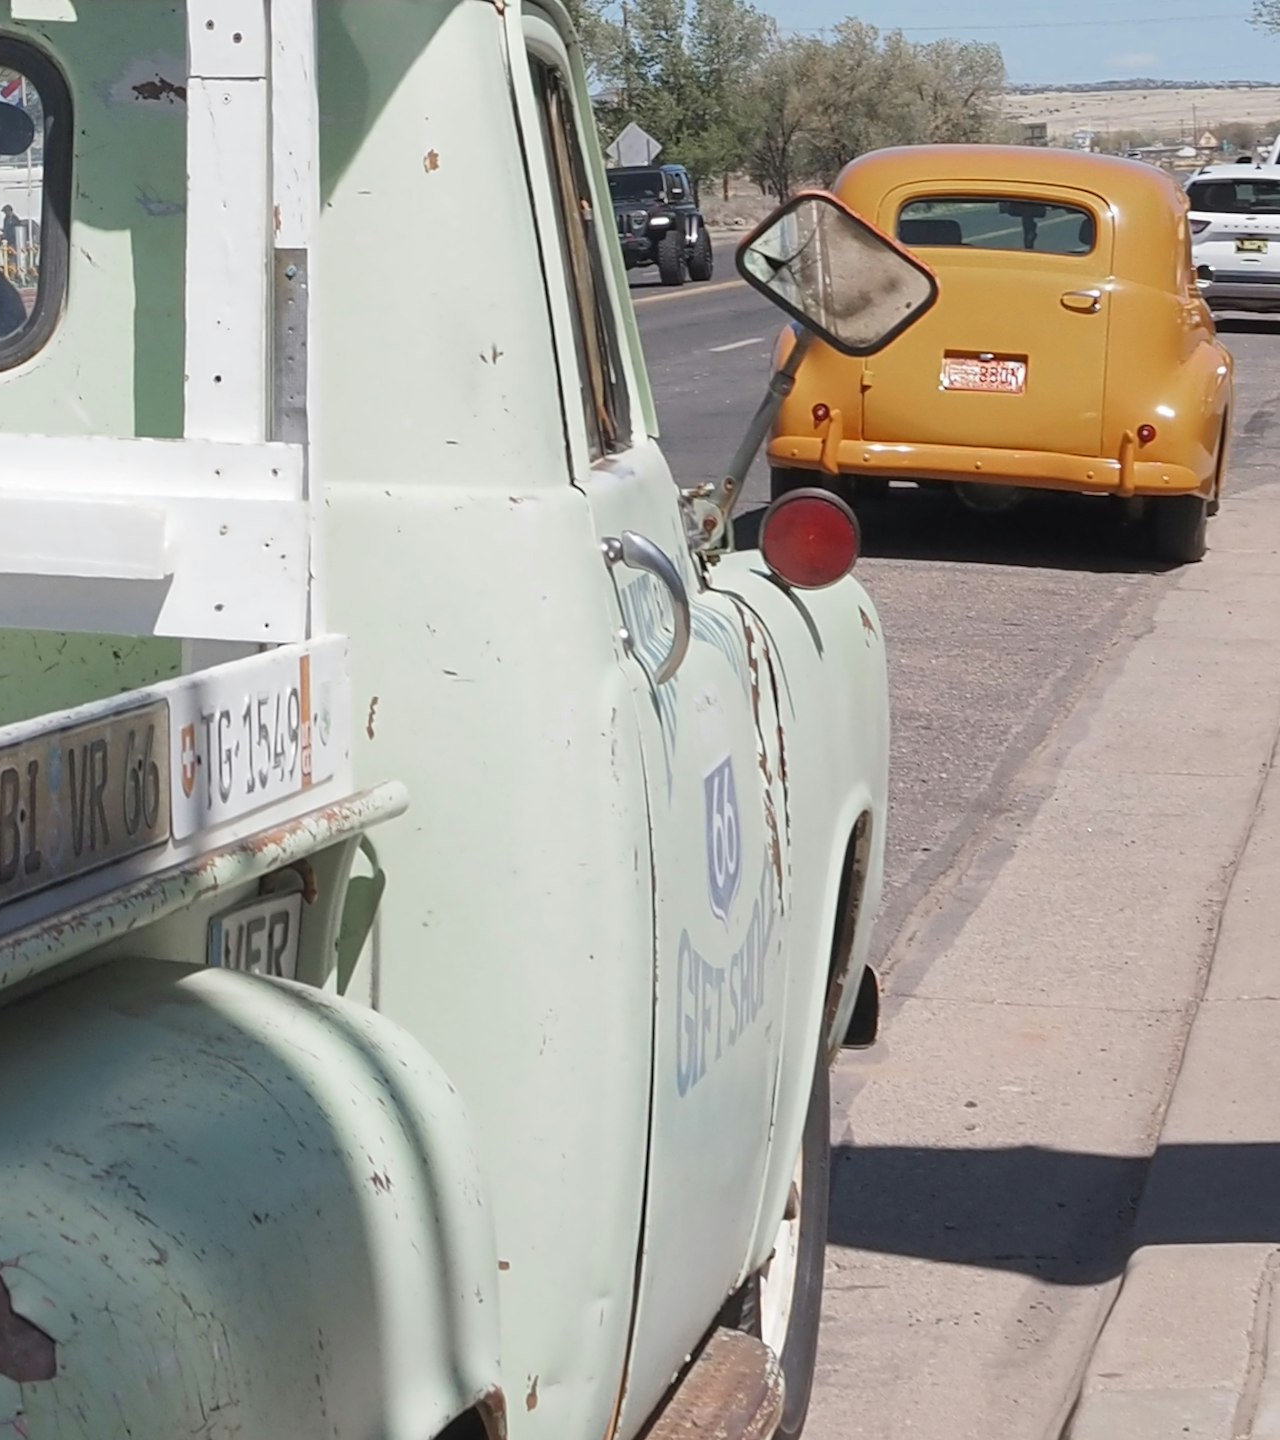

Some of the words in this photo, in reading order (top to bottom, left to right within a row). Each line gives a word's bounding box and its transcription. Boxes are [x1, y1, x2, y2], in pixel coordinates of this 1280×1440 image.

[69, 738, 110, 858] VR
[124, 723, 160, 836] 66
[711, 767, 738, 889] 66
[676, 928, 726, 1098] GIFT
